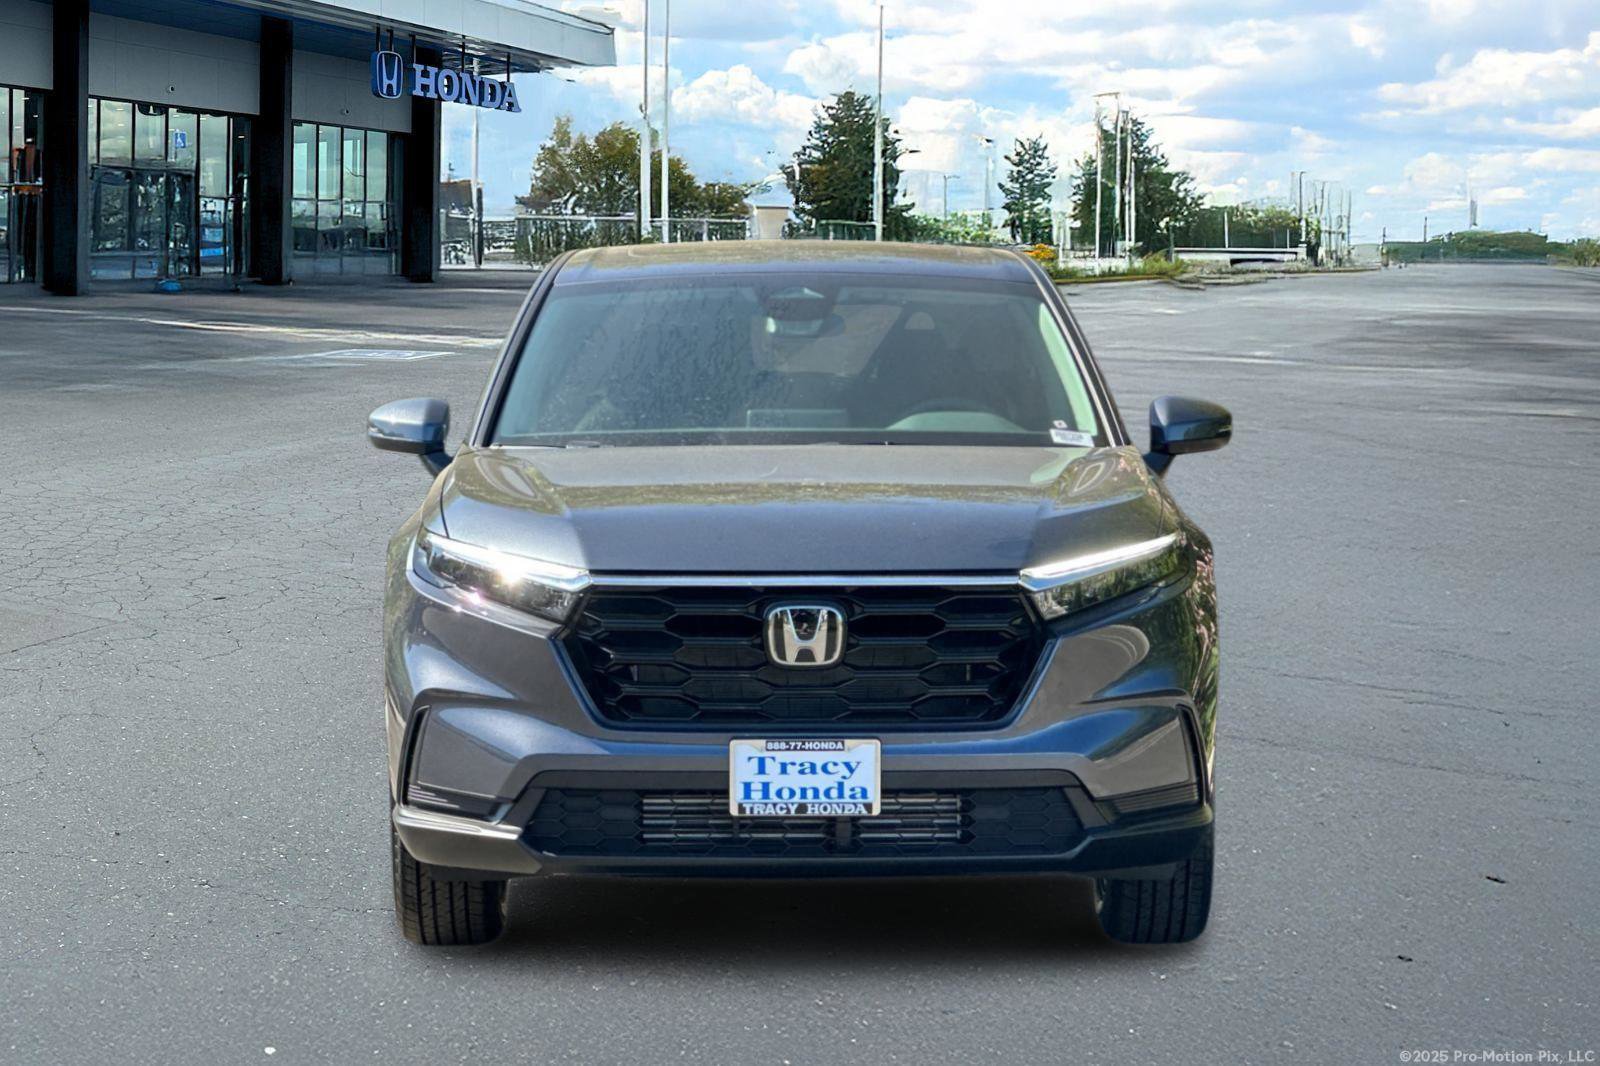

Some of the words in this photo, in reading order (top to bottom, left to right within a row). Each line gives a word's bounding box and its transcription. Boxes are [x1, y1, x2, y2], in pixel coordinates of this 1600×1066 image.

[412, 63, 522, 113] HONDA
[767, 741, 844, 750] 888-77-HONDA
[747, 756, 861, 780] Tracy
[741, 781, 869, 800] Honda
[743, 803, 798, 814] TRACY
[806, 803, 868, 814] HONDA
